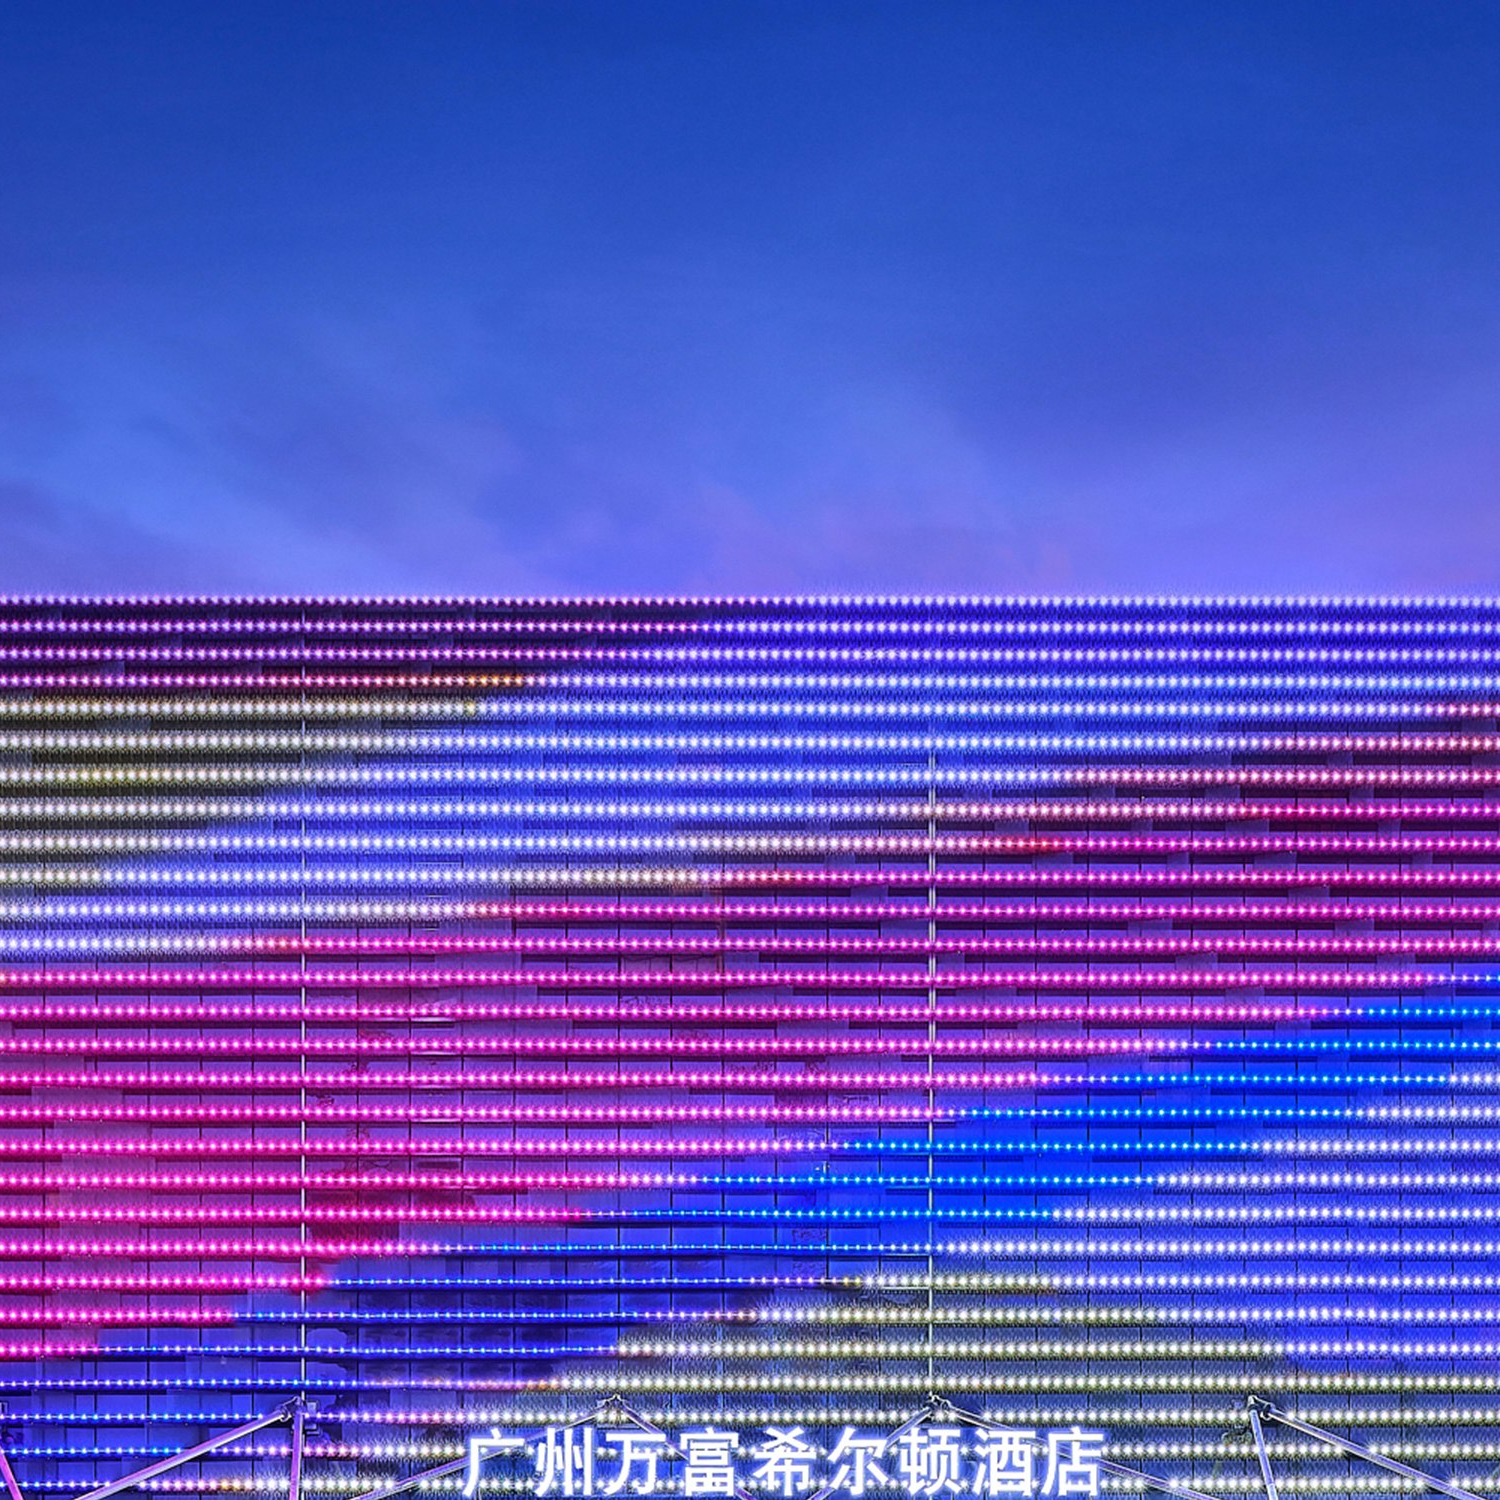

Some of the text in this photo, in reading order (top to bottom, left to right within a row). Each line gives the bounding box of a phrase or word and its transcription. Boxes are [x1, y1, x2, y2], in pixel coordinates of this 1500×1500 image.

[462, 1426, 1104, 1497] 广州万富希尔顿酒店
